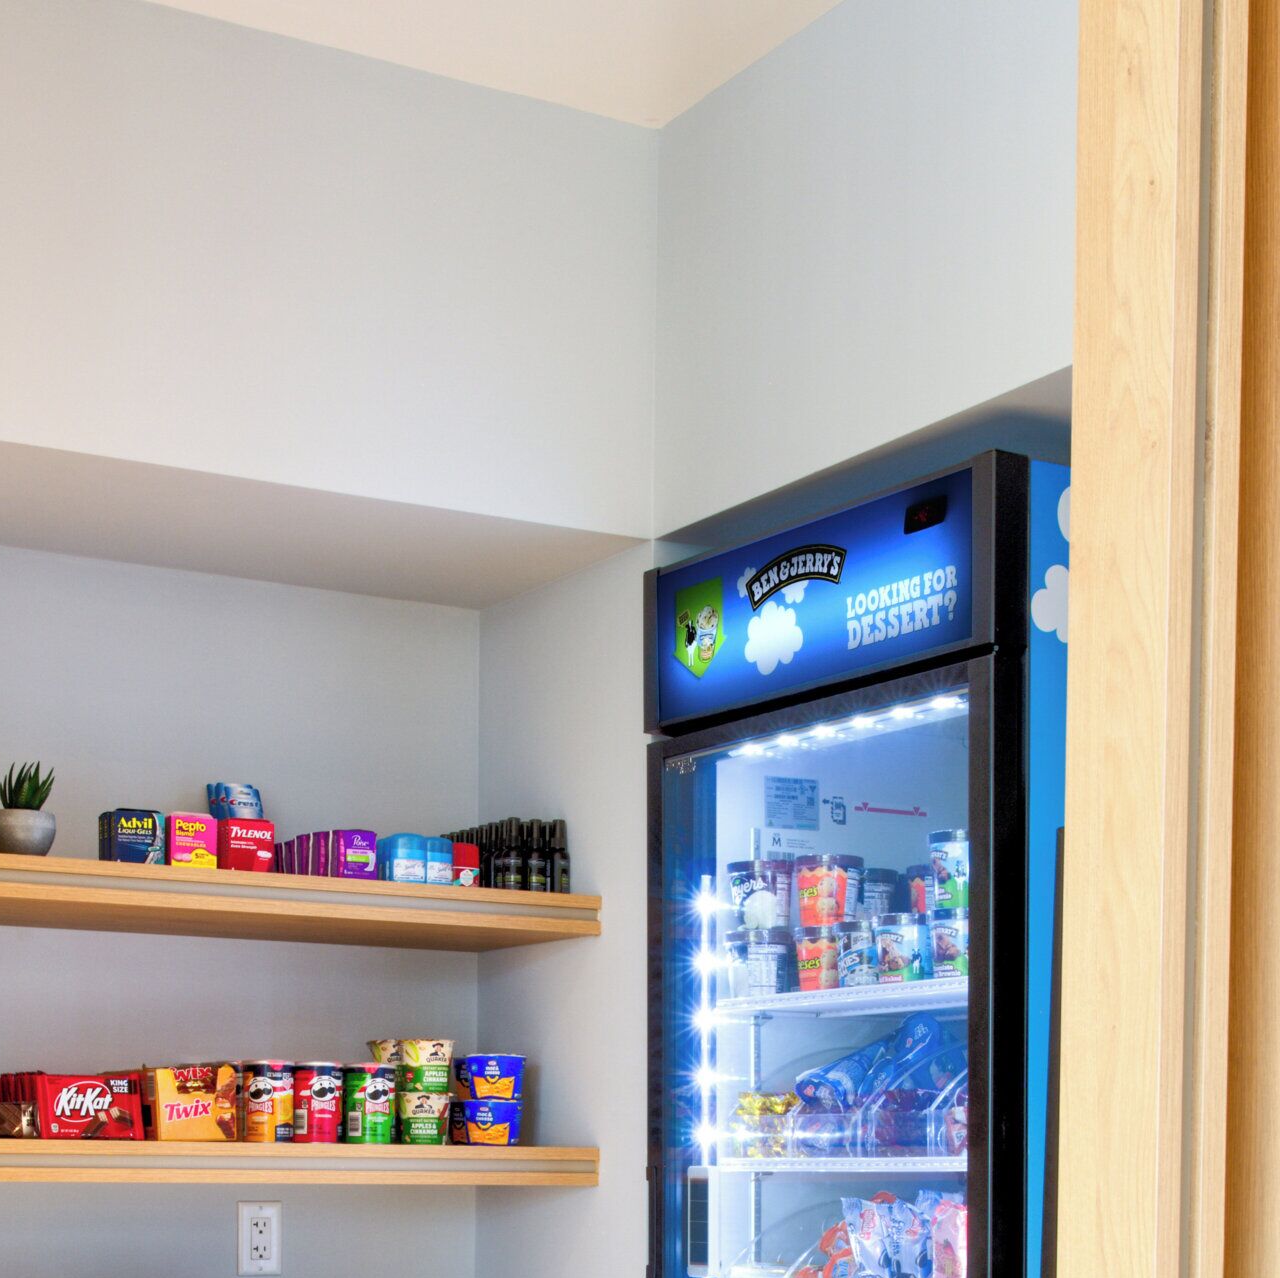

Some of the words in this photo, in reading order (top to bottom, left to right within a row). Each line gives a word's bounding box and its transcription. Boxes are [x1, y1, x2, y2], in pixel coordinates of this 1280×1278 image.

[752, 567, 779, 601] BEN
[779, 563, 790, 581] &
[790, 552, 841, 578] JERRY'S
[847, 575, 920, 618] LOOKING
[923, 565, 957, 595] FOR
[847, 590, 957, 650] DESSERT?
[229, 799, 258, 807] Crest
[118, 817, 152, 829] Advil
[175, 819, 206, 833] Pepto
[230, 826, 272, 839] TYLENOL
[164, 1099, 212, 1121] Twix
[249, 1101, 273, 1113] PRINGLES
